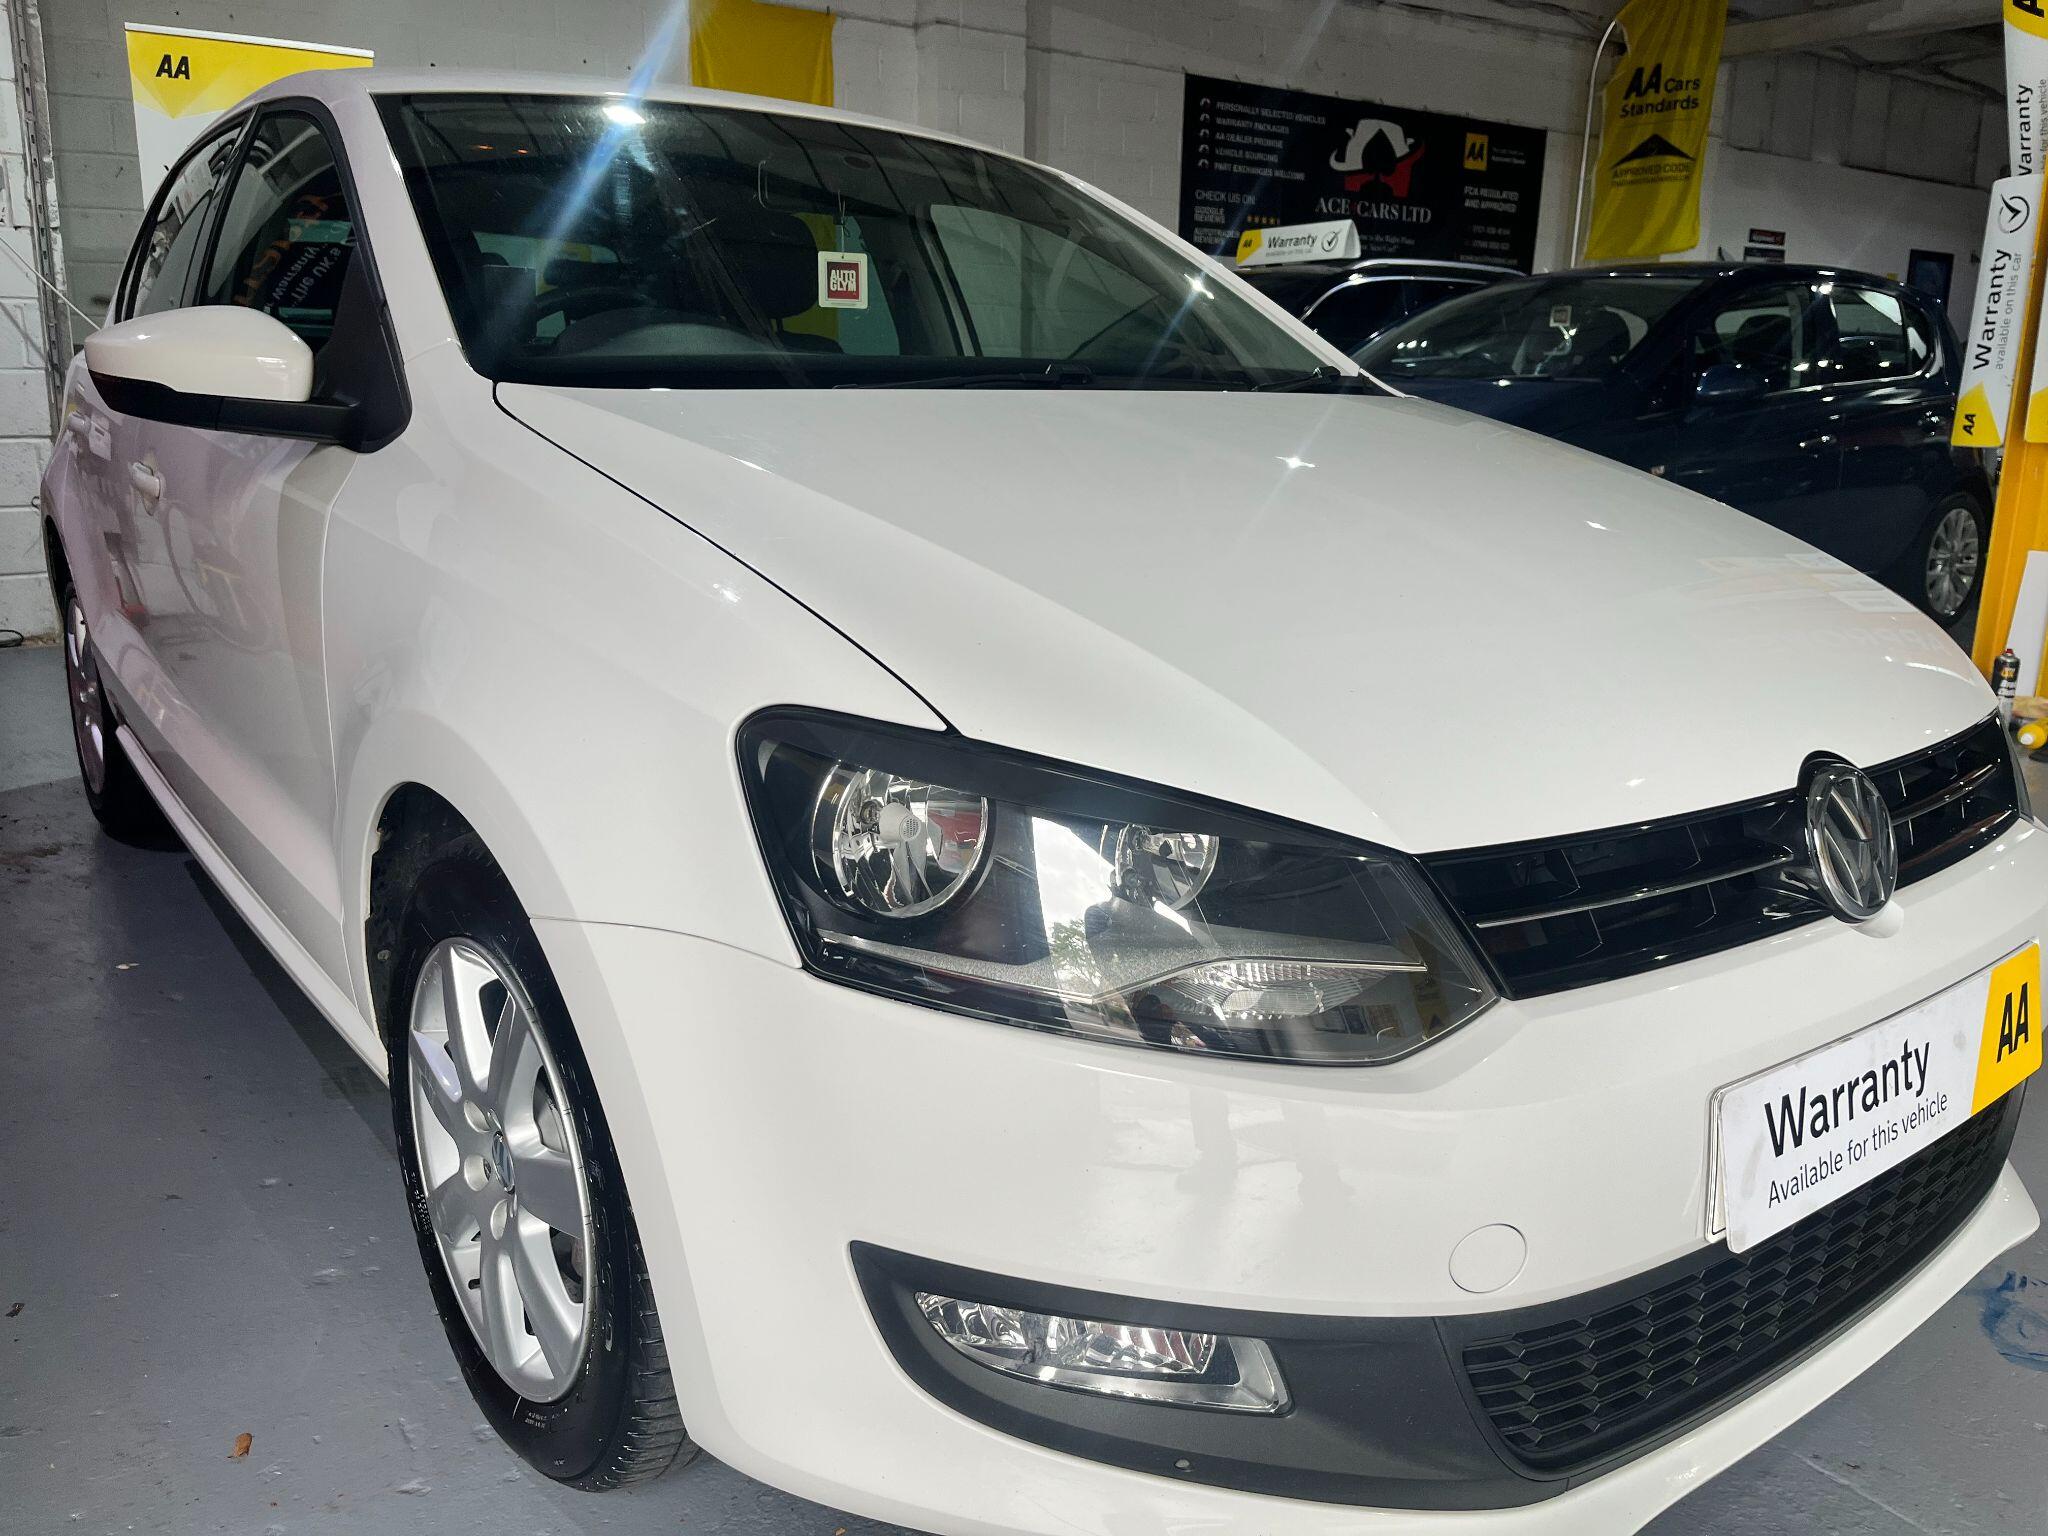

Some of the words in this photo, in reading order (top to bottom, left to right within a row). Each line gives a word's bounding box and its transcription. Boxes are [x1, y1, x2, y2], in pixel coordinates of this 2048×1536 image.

[156, 54, 190, 80] AA
[1623, 63, 1662, 100] AA
[1664, 77, 1701, 94] Cars
[1620, 95, 1699, 119] Standards
[1216, 117, 1253, 130] WARRANTY
[1254, 122, 1290, 135] PACKAGES
[1467, 142, 1486, 161] AA
[1194, 189, 1226, 202] CHECK
[1228, 191, 1241, 203] US
[1315, 197, 1350, 215] ACE
[1356, 200, 1400, 220] CARS
[1402, 206, 1432, 224] LTD
[1268, 232, 1318, 249] Warranty
[2013, 253, 2022, 271] car
[830, 270, 856, 280] AUTO
[830, 280, 856, 292] GLYM
[2006, 276, 2018, 296] this
[1973, 249, 2012, 370] Warranty
[2006, 300, 2014, 315] on
[1996, 318, 2012, 370] available
[1962, 413, 1976, 435] AA
[1996, 981, 2030, 1064] AA
[1763, 1038, 1931, 1159] Warranty
[1768, 1153, 1844, 1209] Available
[1847, 1137, 1869, 1166] for
[1872, 1119, 1899, 1153] this
[1901, 1091, 1948, 1135] vehicle
